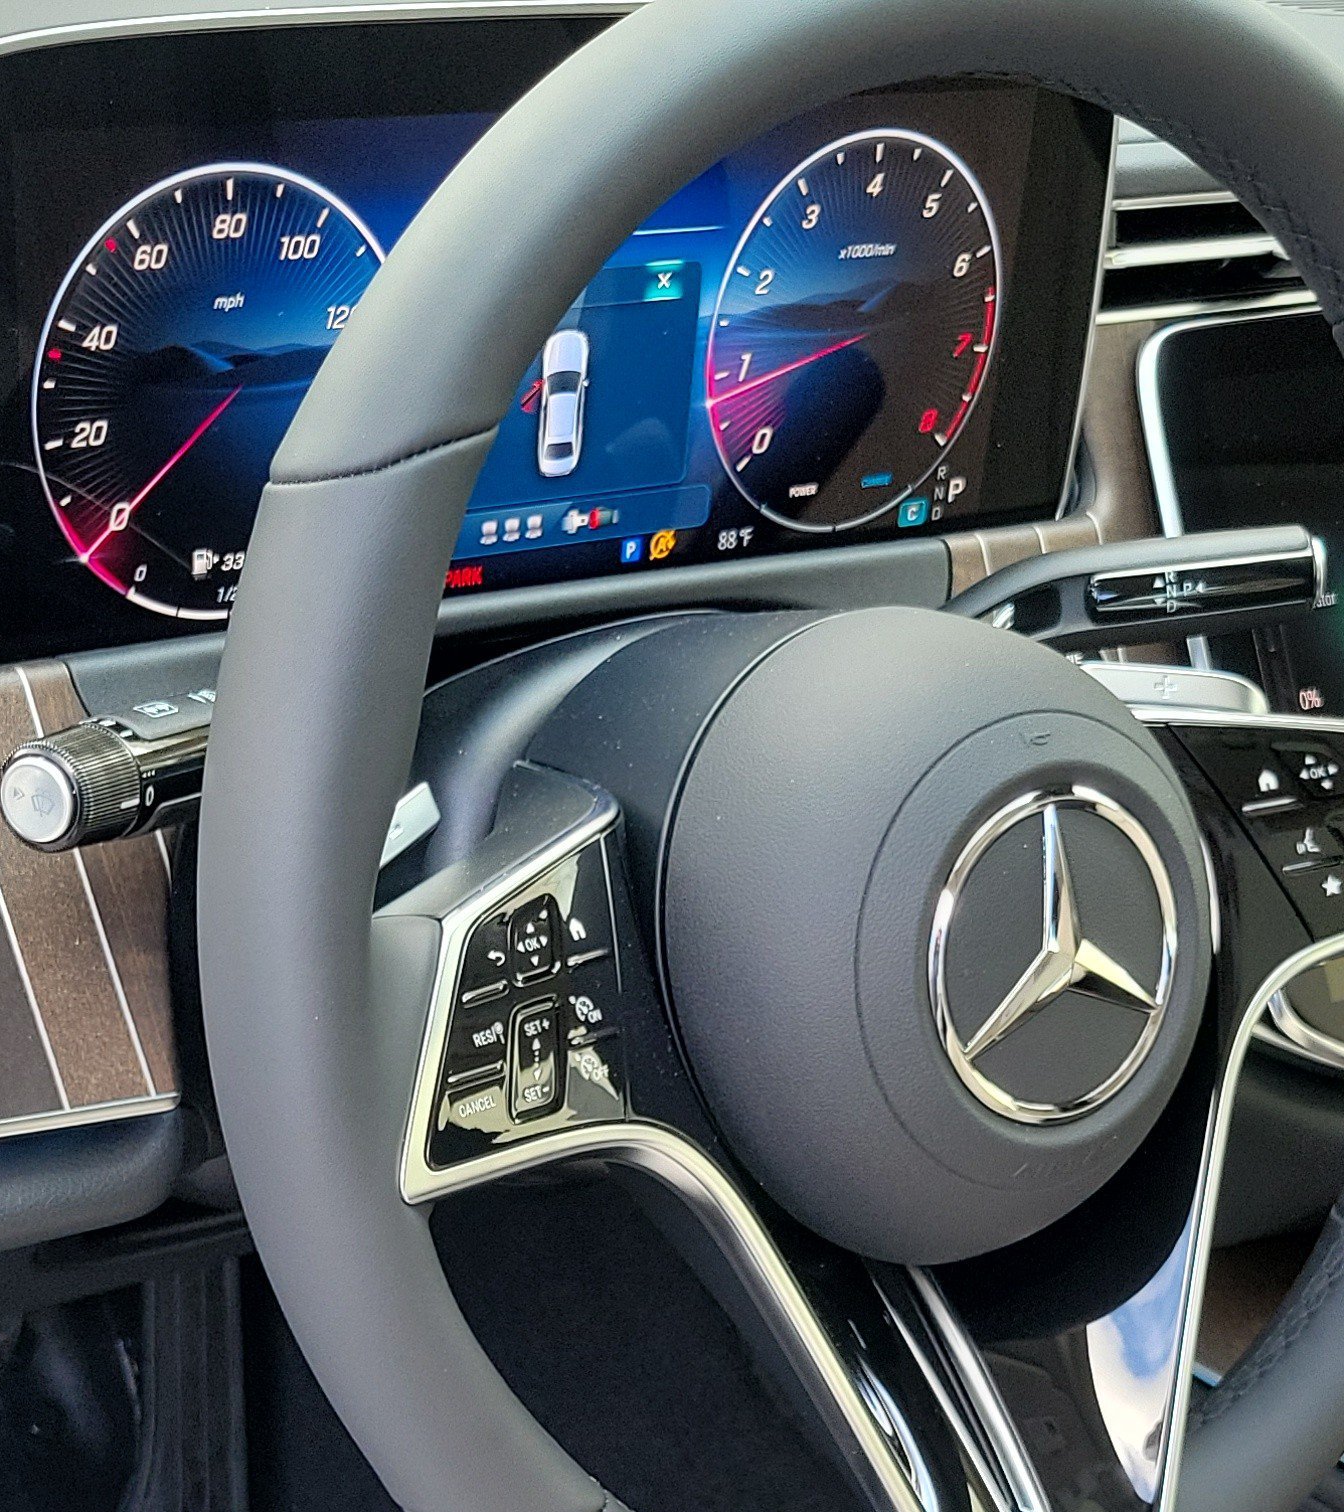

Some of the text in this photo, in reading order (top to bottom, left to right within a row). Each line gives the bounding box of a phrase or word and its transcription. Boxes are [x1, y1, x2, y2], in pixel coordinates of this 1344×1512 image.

[866, 173, 886, 197] 4
[801, 203, 822, 229] 3
[922, 193, 942, 218] 5
[212, 213, 246, 239] 80
[134, 243, 167, 270] 60
[279, 235, 320, 260] 100
[953, 252, 973, 278] 6
[756, 270, 776, 295] 2
[214, 294, 244, 311] mph
[83, 325, 117, 351] 40
[953, 333, 973, 357] 7
[738, 353, 753, 381] 1
[919, 408, 938, 433] 8
[71, 420, 108, 447] 20
[752, 426, 773, 455] 0
[948, 476, 967, 503] P
[109, 502, 131, 531] 0
[134, 565, 147, 583] 0
[1310, 765, 1327, 780] OK
[525, 938, 540, 952] OK
[459, 1095, 497, 1118] CANCEL
